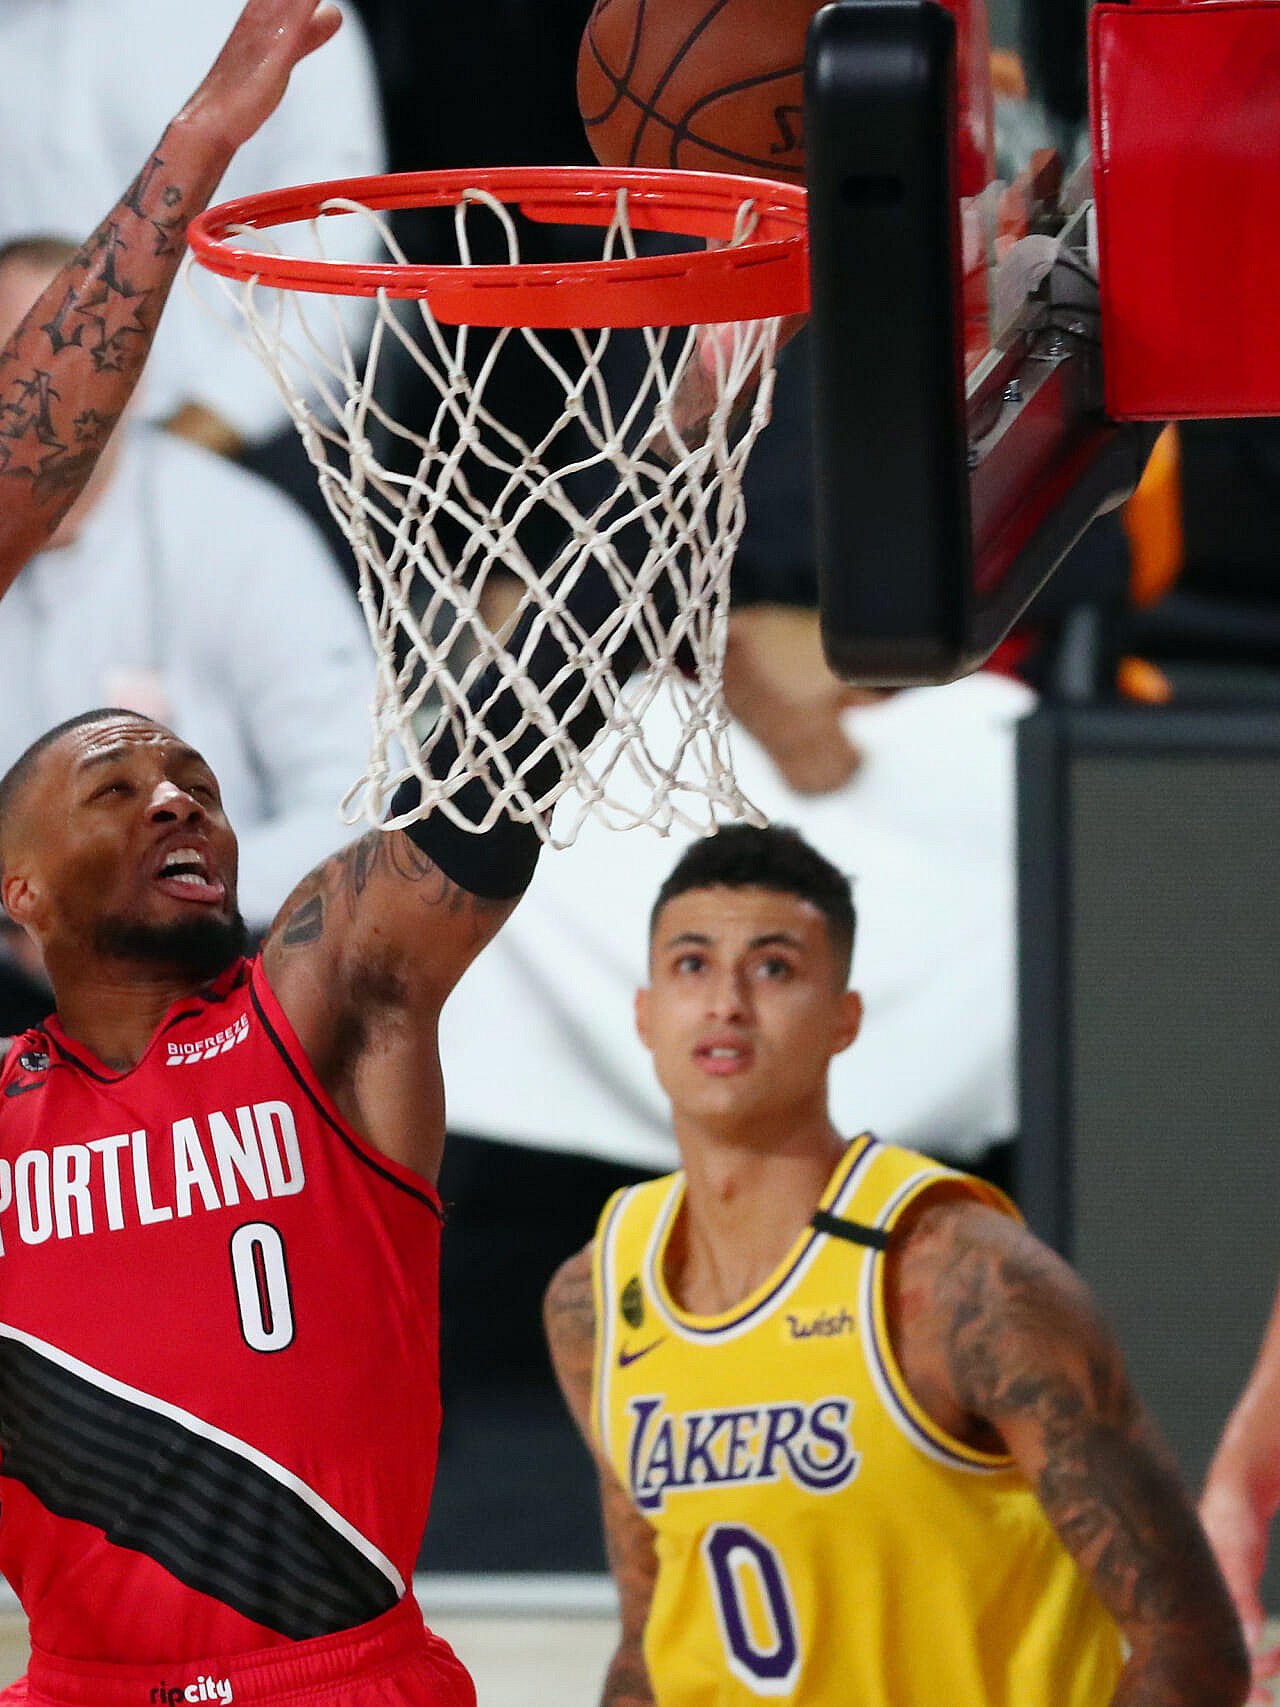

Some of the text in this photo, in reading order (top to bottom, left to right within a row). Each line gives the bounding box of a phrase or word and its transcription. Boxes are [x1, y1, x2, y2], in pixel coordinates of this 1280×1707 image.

[167, 1012, 249, 1055] BIOFREEZE
[230, 1220, 295, 1353] 0
[786, 1307, 855, 1338] wish
[628, 1395, 862, 1513] LAKERS
[700, 1521, 802, 1697] 0
